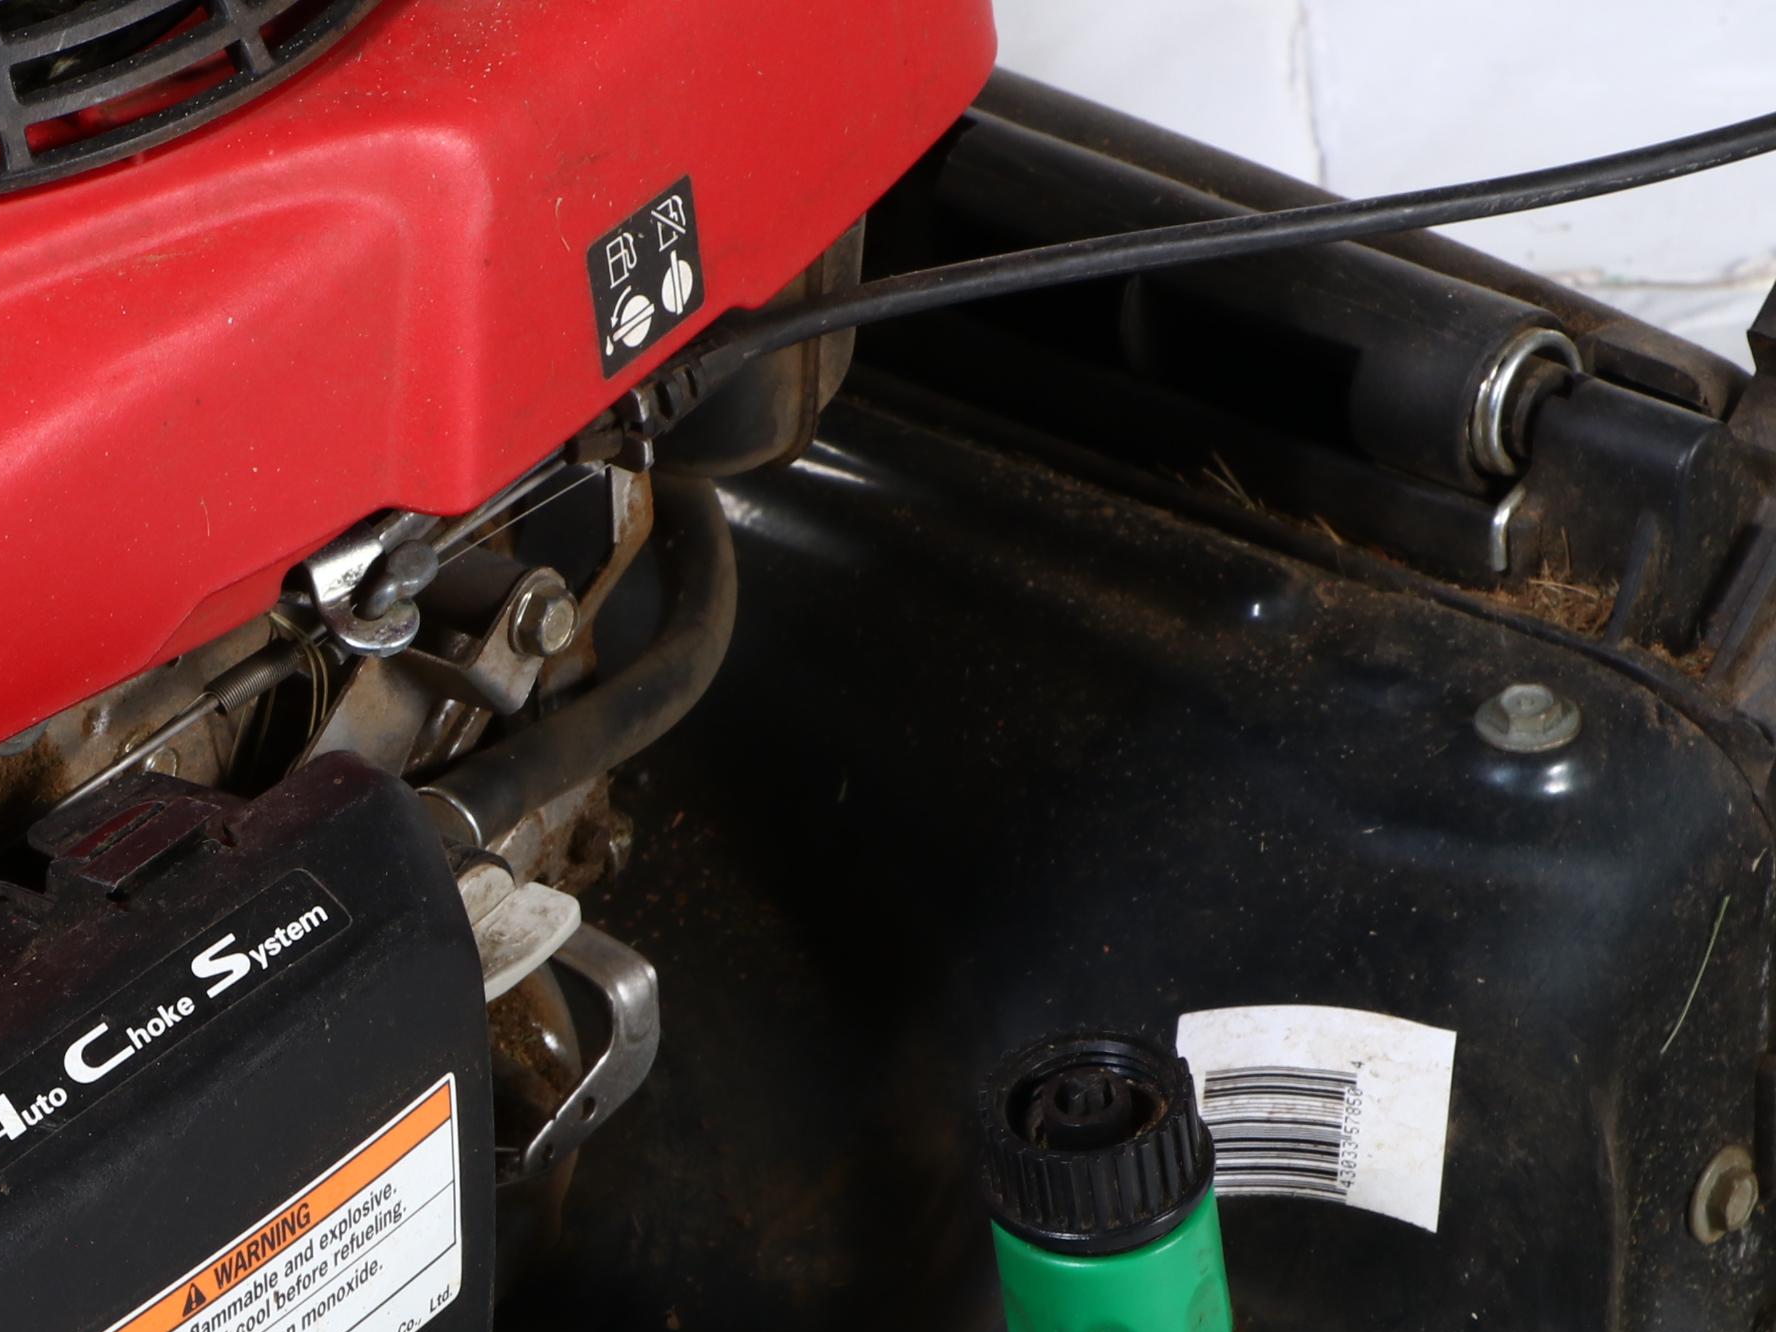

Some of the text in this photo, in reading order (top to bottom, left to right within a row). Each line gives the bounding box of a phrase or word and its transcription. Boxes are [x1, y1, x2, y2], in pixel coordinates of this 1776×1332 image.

[64, 996, 195, 1084] Choke
[191, 905, 329, 998] System
[1339, 1060, 1365, 1189] 43033 57850 4
[214, 1202, 311, 1290] WARNING
[276, 1261, 328, 1311] before
[334, 1200, 407, 1268] refueling.
[284, 1239, 314, 1278] and
[319, 1182, 397, 1250] explosive.
[301, 1259, 383, 1330] monoxide.
[429, 1285, 453, 1314] Ltd.
